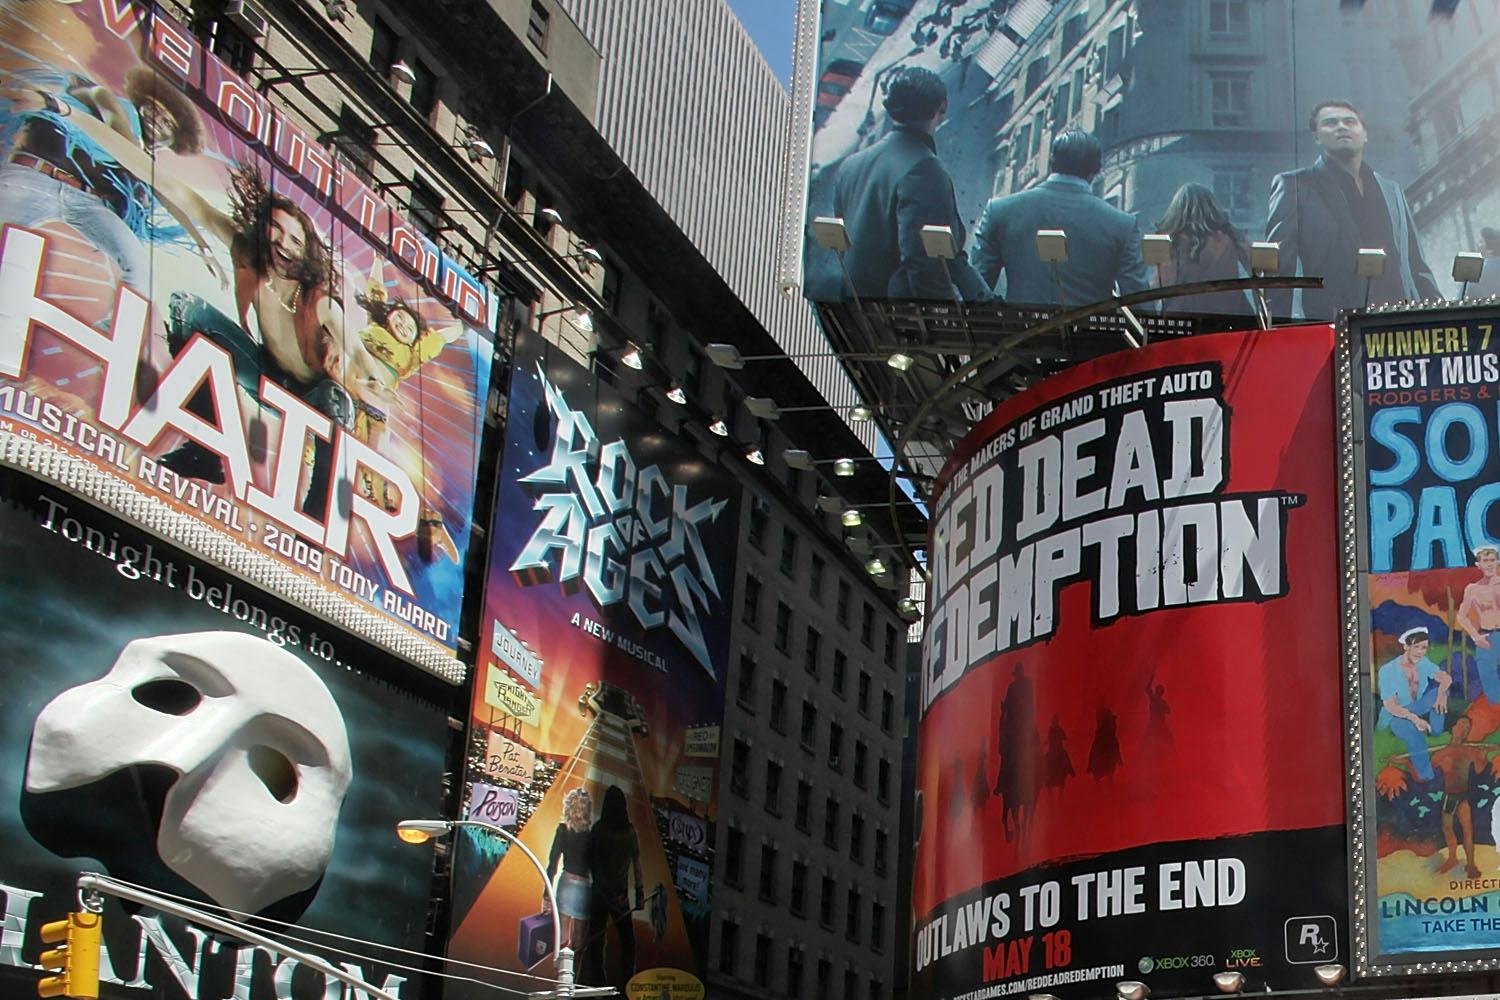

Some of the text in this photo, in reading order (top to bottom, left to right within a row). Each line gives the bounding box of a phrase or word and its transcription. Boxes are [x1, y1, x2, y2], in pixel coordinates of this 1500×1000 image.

[1365, 327, 1469, 358] WINNER!
[1477, 325, 1493, 350] 7
[1366, 358, 1432, 390] BEST
[1368, 386, 1471, 406] RODGERS
[1478, 386, 1491, 399] &
[0, 222, 416, 598] HAIR
[971, 431, 1016, 469] MAKERS
[1020, 416, 1036, 440] OF
[1040, 395, 1094, 431] GRAND
[1099, 378, 1155, 409] THEFT
[1161, 369, 1213, 395] AUTO
[516, 360, 728, 600] ROCK
[931, 398, 1223, 614] RED DEAD
[38, 494, 176, 588] Tonight
[187, 564, 300, 647] belongs
[138, 455, 244, 532] REVIVAL
[263, 523, 324, 574] 2009
[329, 558, 379, 603] TONY
[383, 589, 448, 641] AWARD
[509, 492, 718, 682] AGES
[920, 496, 1280, 718] REDEMPTION
[496, 632, 538, 681] JOURNEY
[571, 612, 669, 673] A NEW MUSICAL
[503, 741, 519, 763] Pat
[917, 858, 1246, 973] OUTLAWS TO THE END
[1382, 895, 1489, 919] LINCOLN
[1422, 919, 1466, 934] TAKE
[982, 929, 1072, 983] MAY 18
[1156, 956, 1189, 970] XBOX
[1226, 957, 1262, 969] LIVE
[1230, 949, 1255, 959] XBOX
